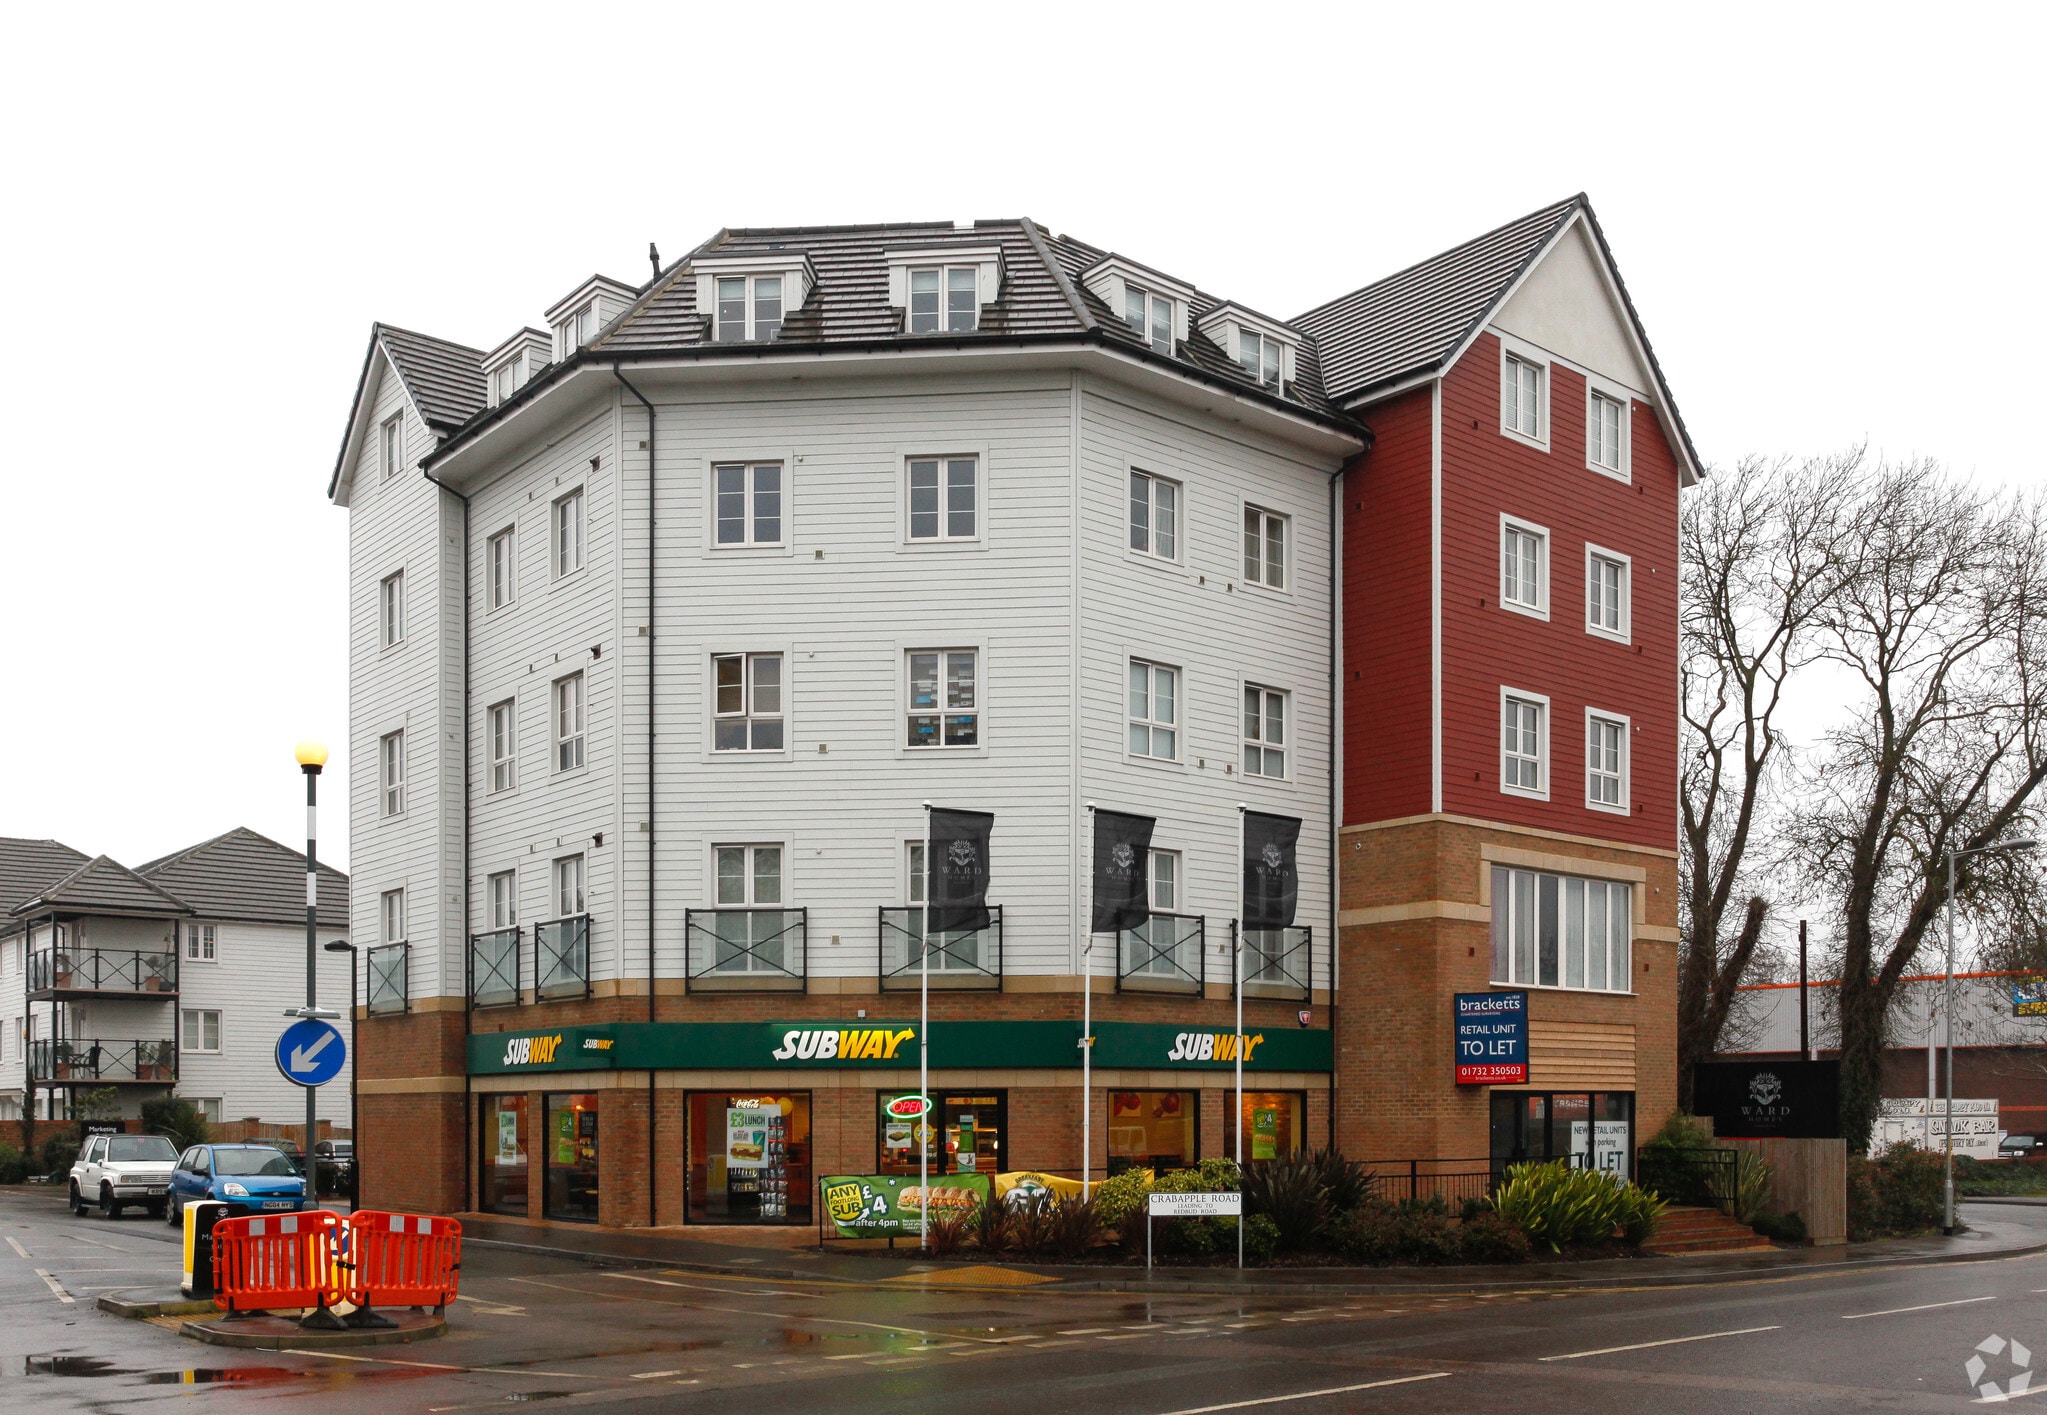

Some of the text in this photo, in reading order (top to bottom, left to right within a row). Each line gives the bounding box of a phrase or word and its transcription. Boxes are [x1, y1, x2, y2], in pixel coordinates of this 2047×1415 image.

[941, 866, 982, 874] WARD
[1105, 867, 1139, 877] WARD
[1256, 866, 1289, 877] WARD
[1460, 998, 1520, 1011] bracketts
[1460, 1024, 1516, 1035] RETAIL UNIT
[583, 1038, 614, 1050] SUBWAY
[772, 1027, 915, 1061] SUBWAY
[1460, 1040, 1516, 1056] TO LET
[503, 1033, 562, 1067] SUBWAY
[1461, 1066, 1521, 1076] 01732 350503
[892, 1101, 924, 1113] OPEN
[1741, 1106, 1790, 1116] WARD
[730, 1112, 766, 1128] £3 LUNCH
[1574, 1126, 1627, 1135] NEW ETAIL UNITS
[1974, 1119, 1996, 1135] BAR
[1598, 1137, 1616, 1148] parking
[1600, 1150, 1624, 1171] LET
[830, 1185, 857, 1199] ANY
[830, 1195, 859, 1205] FOOTLONG
[1150, 1194, 1239, 1203] CRABAPPLE ROAD
[832, 1202, 861, 1217] SUB
[855, 1219, 877, 1227] after
[878, 1218, 899, 1228] 4pm
